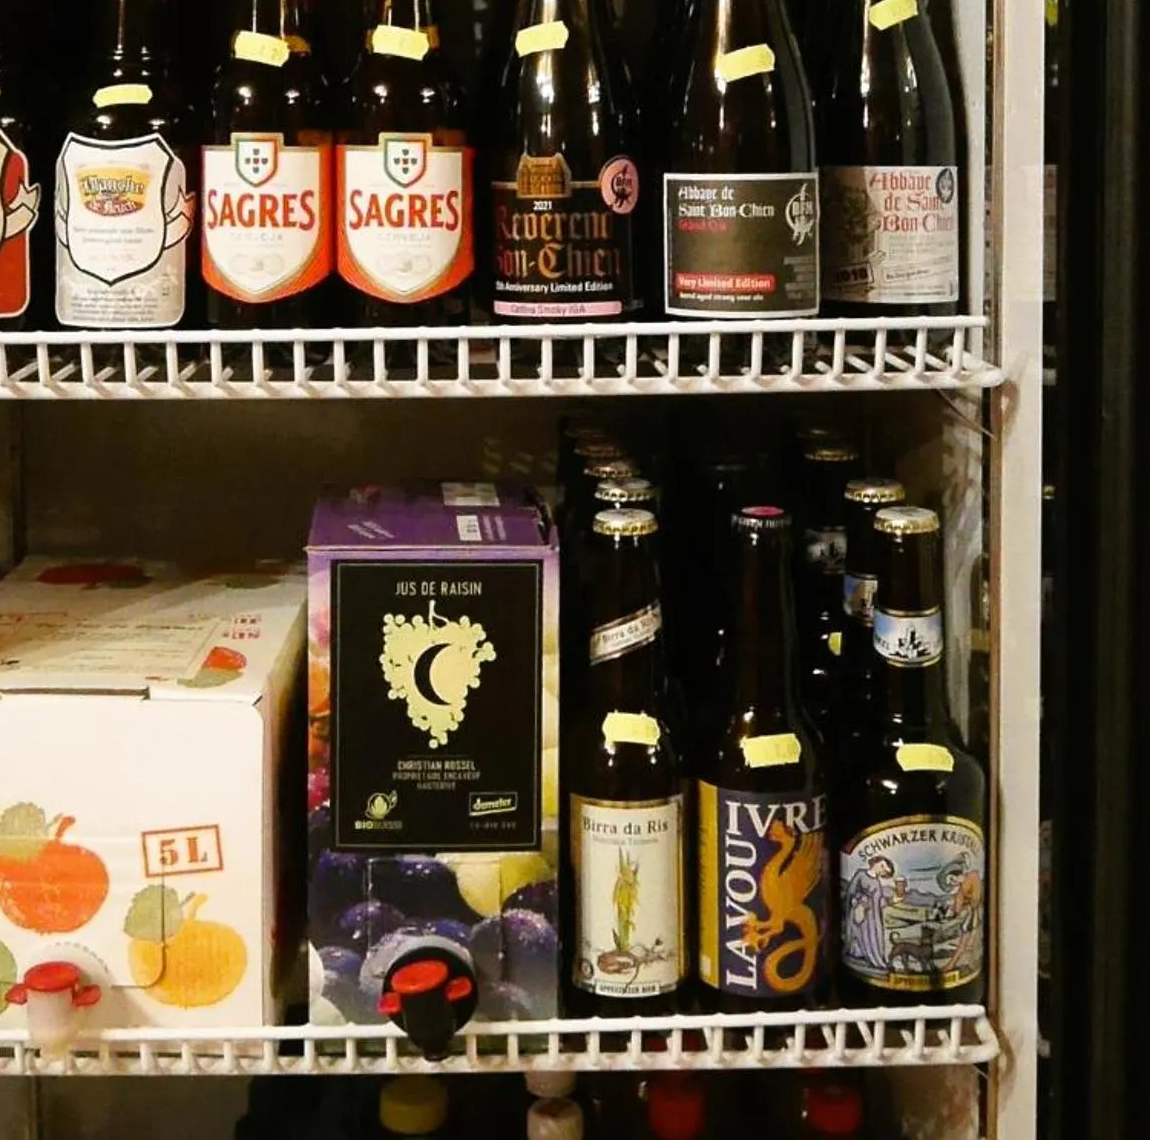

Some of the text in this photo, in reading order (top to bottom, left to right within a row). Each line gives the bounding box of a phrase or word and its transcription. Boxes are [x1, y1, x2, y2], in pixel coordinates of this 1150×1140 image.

[207, 189, 315, 232] SAGRES
[350, 189, 459, 232] SAGRES
[550, 281, 583, 293] Limited
[585, 280, 614, 292] Edition
[698, 275, 734, 289] Limited
[735, 275, 771, 289] Edition
[395, 581, 483, 597] JUS DE RAISIN
[583, 816, 669, 836] Birra da Ris
[857, 829, 937, 862] SCHWARZER
